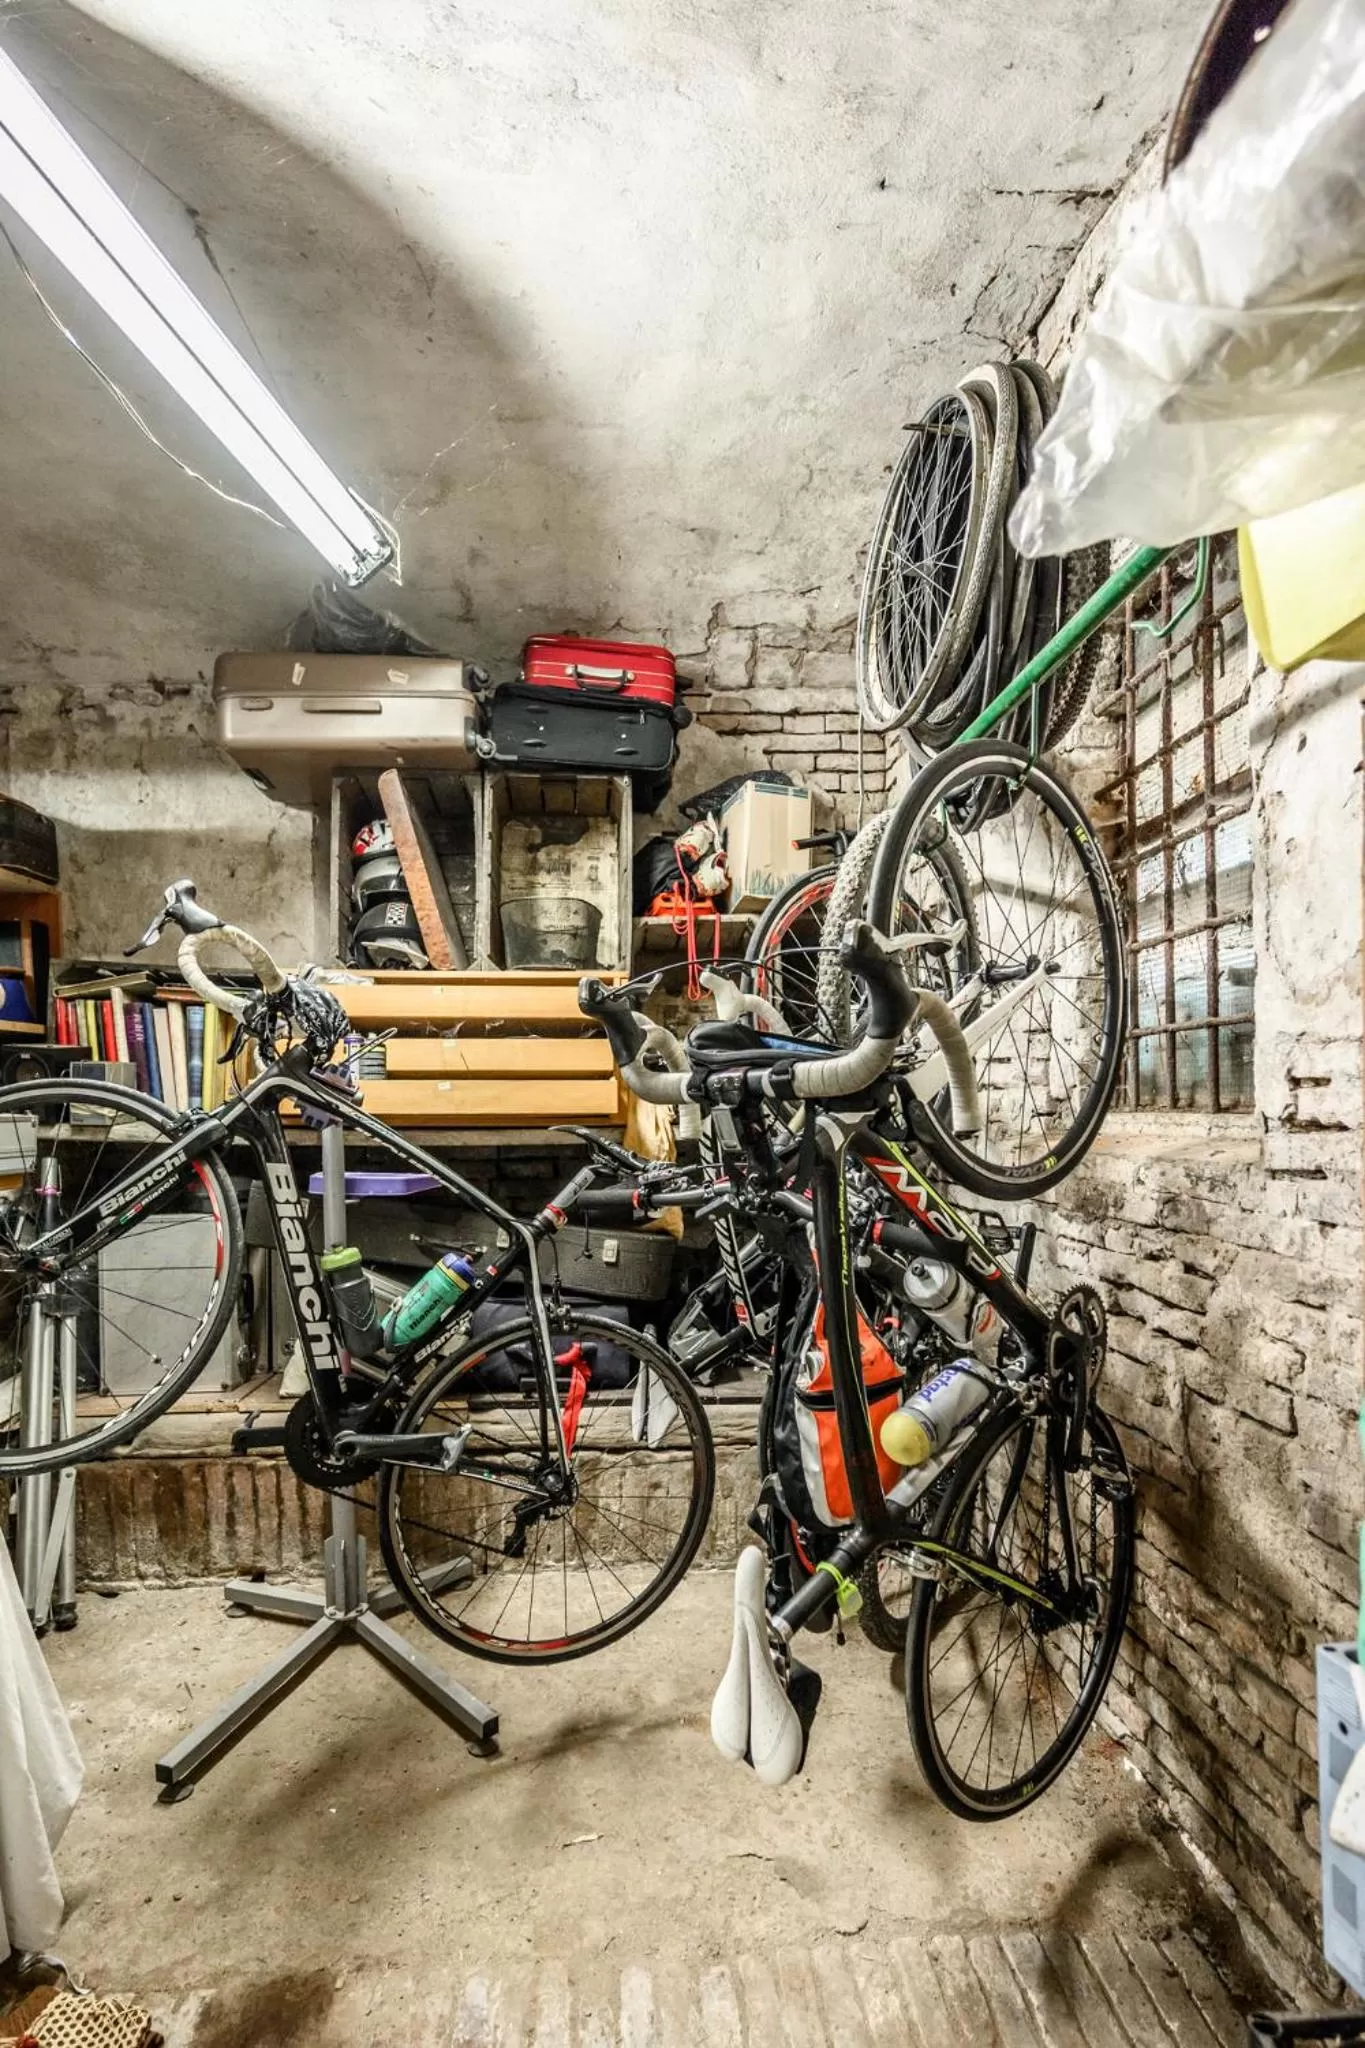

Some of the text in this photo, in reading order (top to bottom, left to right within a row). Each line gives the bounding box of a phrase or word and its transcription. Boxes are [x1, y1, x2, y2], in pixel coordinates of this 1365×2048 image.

[99, 1149, 187, 1217] Bianchi
[266, 1162, 340, 1370] Bianchi
[408, 1295, 444, 1331] Bianchi
